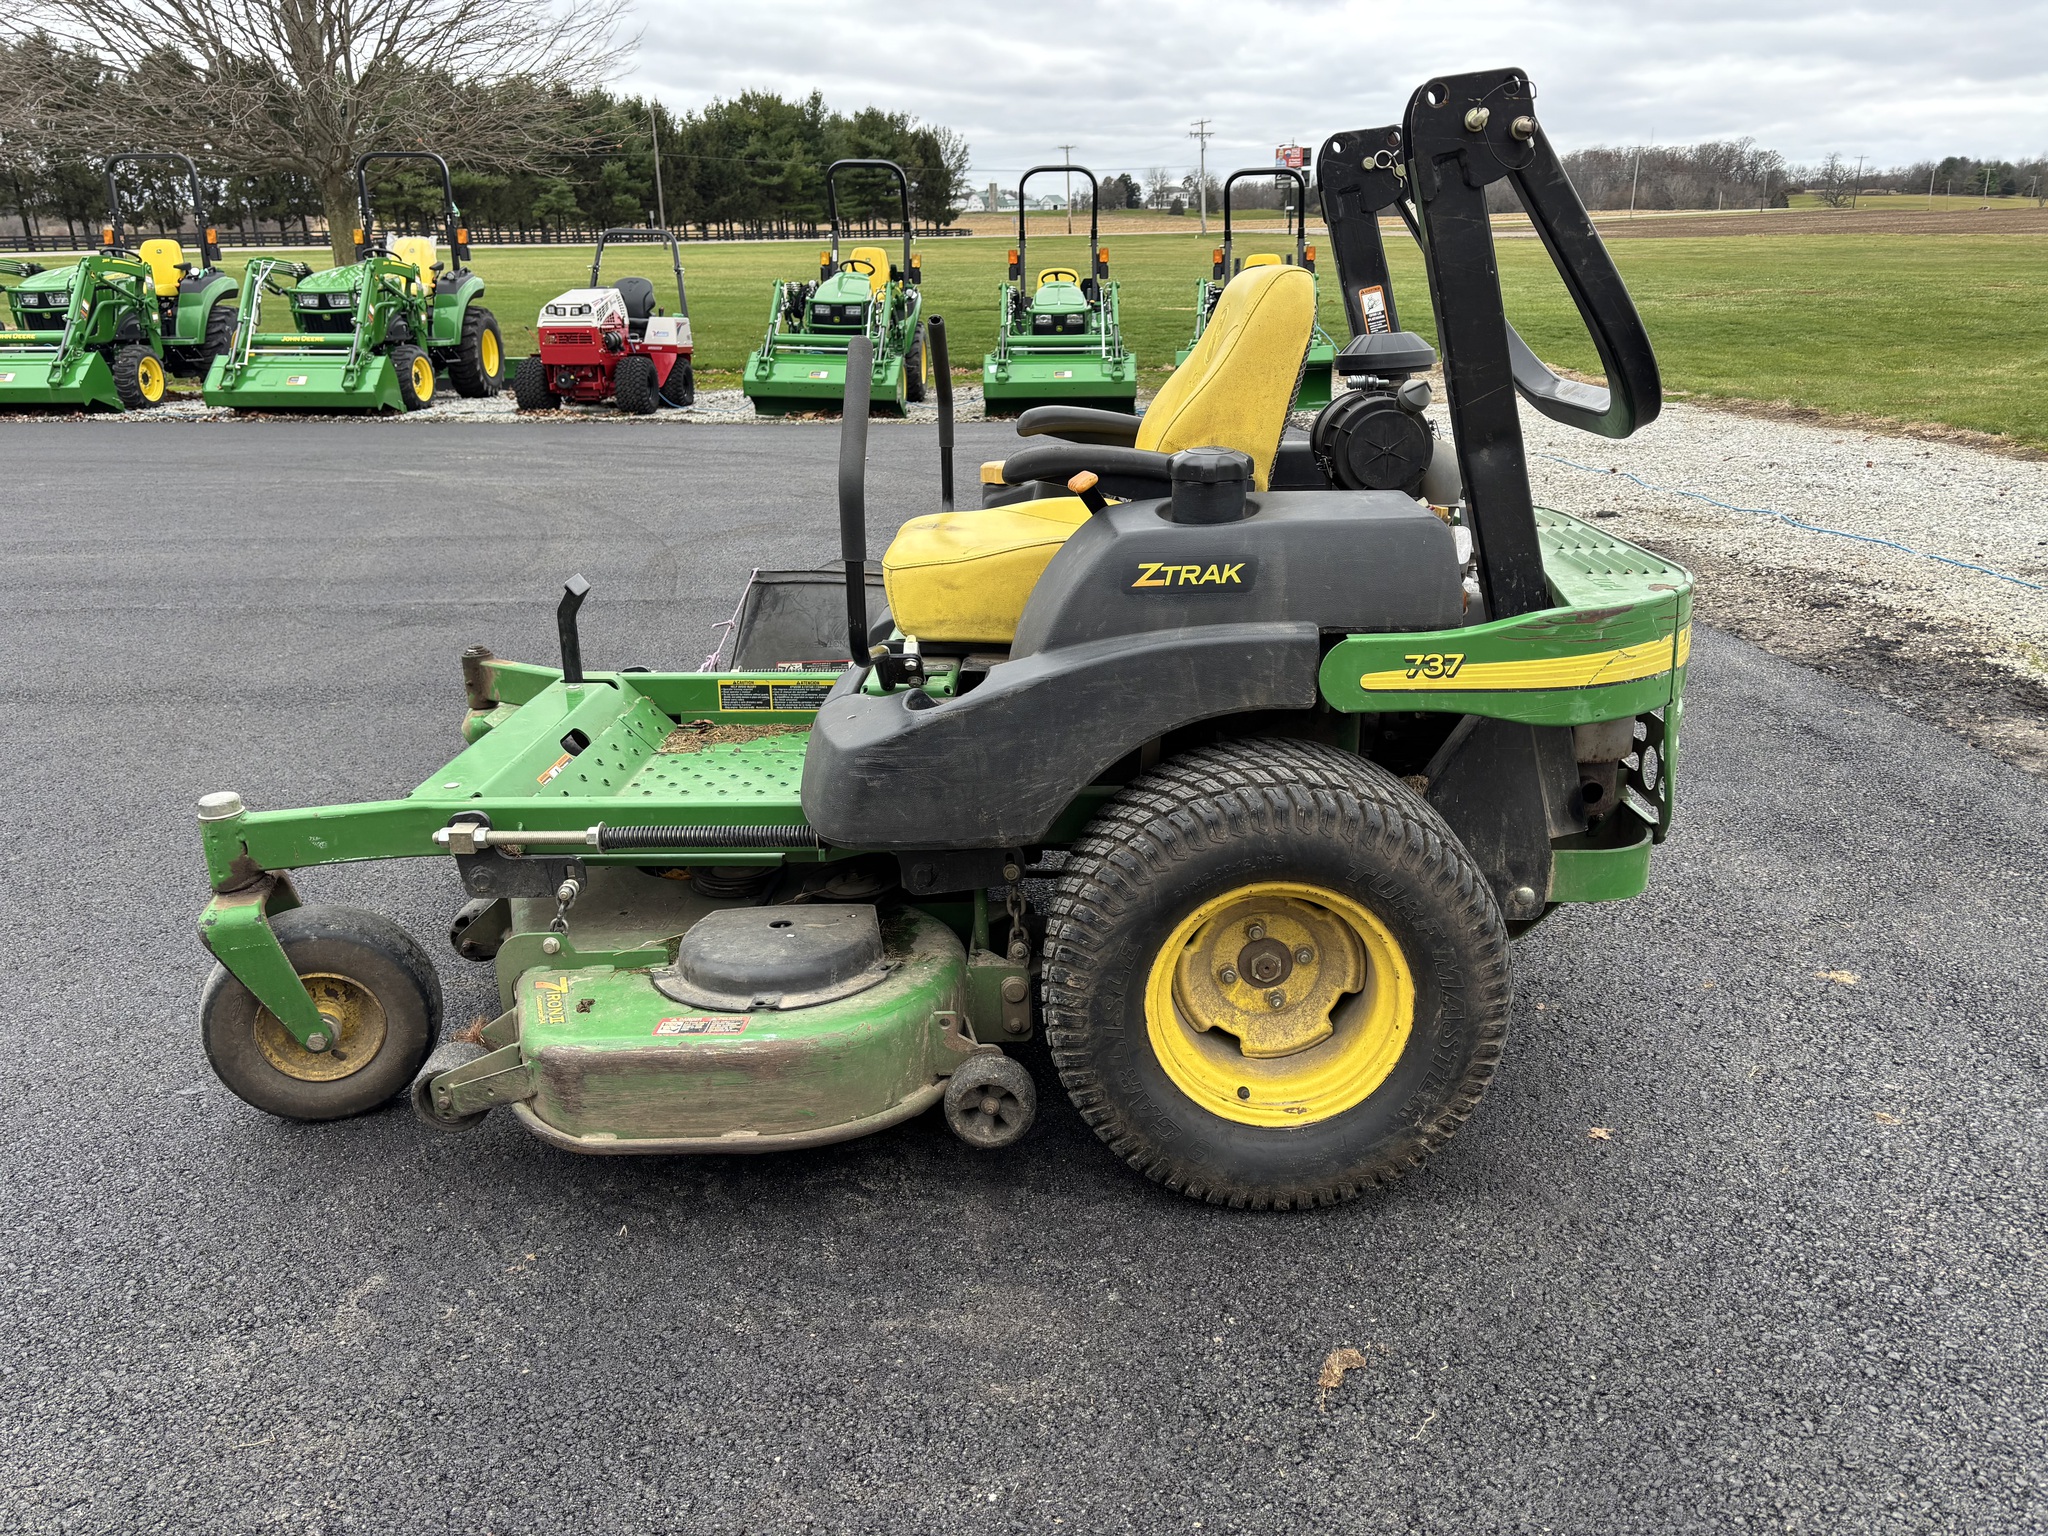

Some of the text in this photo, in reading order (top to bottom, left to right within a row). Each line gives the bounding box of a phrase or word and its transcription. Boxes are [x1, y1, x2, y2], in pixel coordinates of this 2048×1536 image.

[1131, 562, 1246, 587] ZTRAK
[1404, 652, 1467, 679] 737
[1102, 936, 1184, 1144] CARLISLE
[1346, 859, 1468, 1127] TURF MASTER
